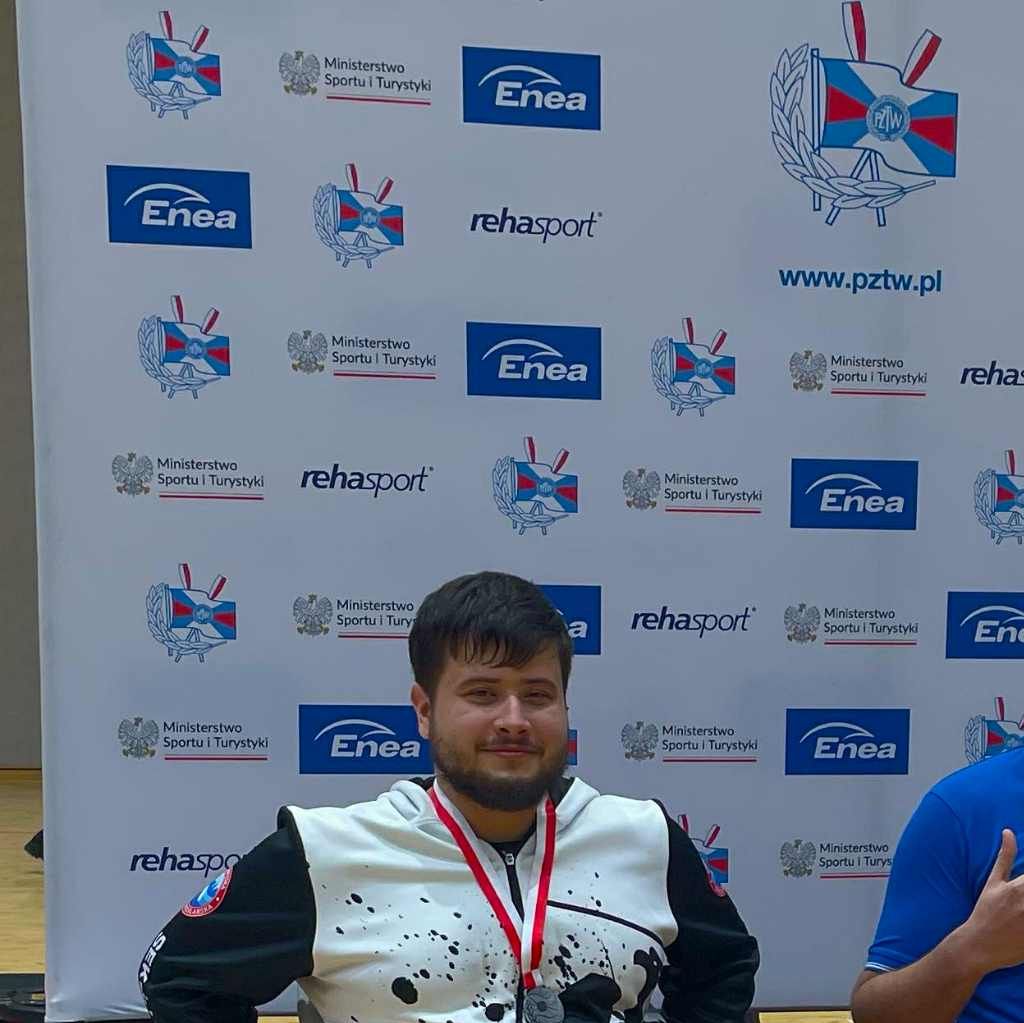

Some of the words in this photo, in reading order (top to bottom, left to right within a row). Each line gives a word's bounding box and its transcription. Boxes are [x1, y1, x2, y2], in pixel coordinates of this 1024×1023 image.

[324, 57, 405, 73] Ministerstwo
[324, 73, 365, 91] Sportu
[376, 76, 431, 94] Turystyki
[496, 81, 586, 110] Enea
[142, 200, 236, 228] Enea
[778, 269, 942, 297] www.pztw.pl
[332, 336, 410, 350] Ministerstwo
[332, 351, 372, 366] Sportu
[382, 353, 436, 368] Turystyki
[831, 355, 904, 368] Ministerstwo
[499, 355, 587, 381] Enea
[830, 370, 867, 383] Sportu
[877, 371, 927, 385] Turystyki
[157, 457, 238, 471] Ministerstwo
[158, 473, 199, 487] Sportu
[208, 474, 264, 489] Turystyki
[665, 473, 739, 486] Ministerstwo
[664, 488, 702, 502] Sportu
[711, 489, 762, 503] Turystyki
[821, 489, 904, 512] Enea
[337, 599, 413, 612] Ministerstwo
[337, 614, 376, 627] Sportu
[824, 608, 895, 619] Ministerstwo
[824, 622, 860, 635] Sportu
[869, 622, 918, 635] Turystyki
[163, 721, 242, 733] Ministerstwo
[662, 725, 734, 736] Ministerstwo
[163, 736, 204, 750] Sportu
[213, 737, 268, 750] Turystyki
[331, 735, 420, 757] Enea
[662, 739, 699, 752] Sportu
[708, 739, 758, 752] Turystyki
[814, 737, 896, 758] Enea
[820, 843, 889, 853] Ministerstwo
[129, 846, 242, 879] rehaspo
[819, 857, 854, 869] Sportu
[863, 856, 892, 868] Turys
